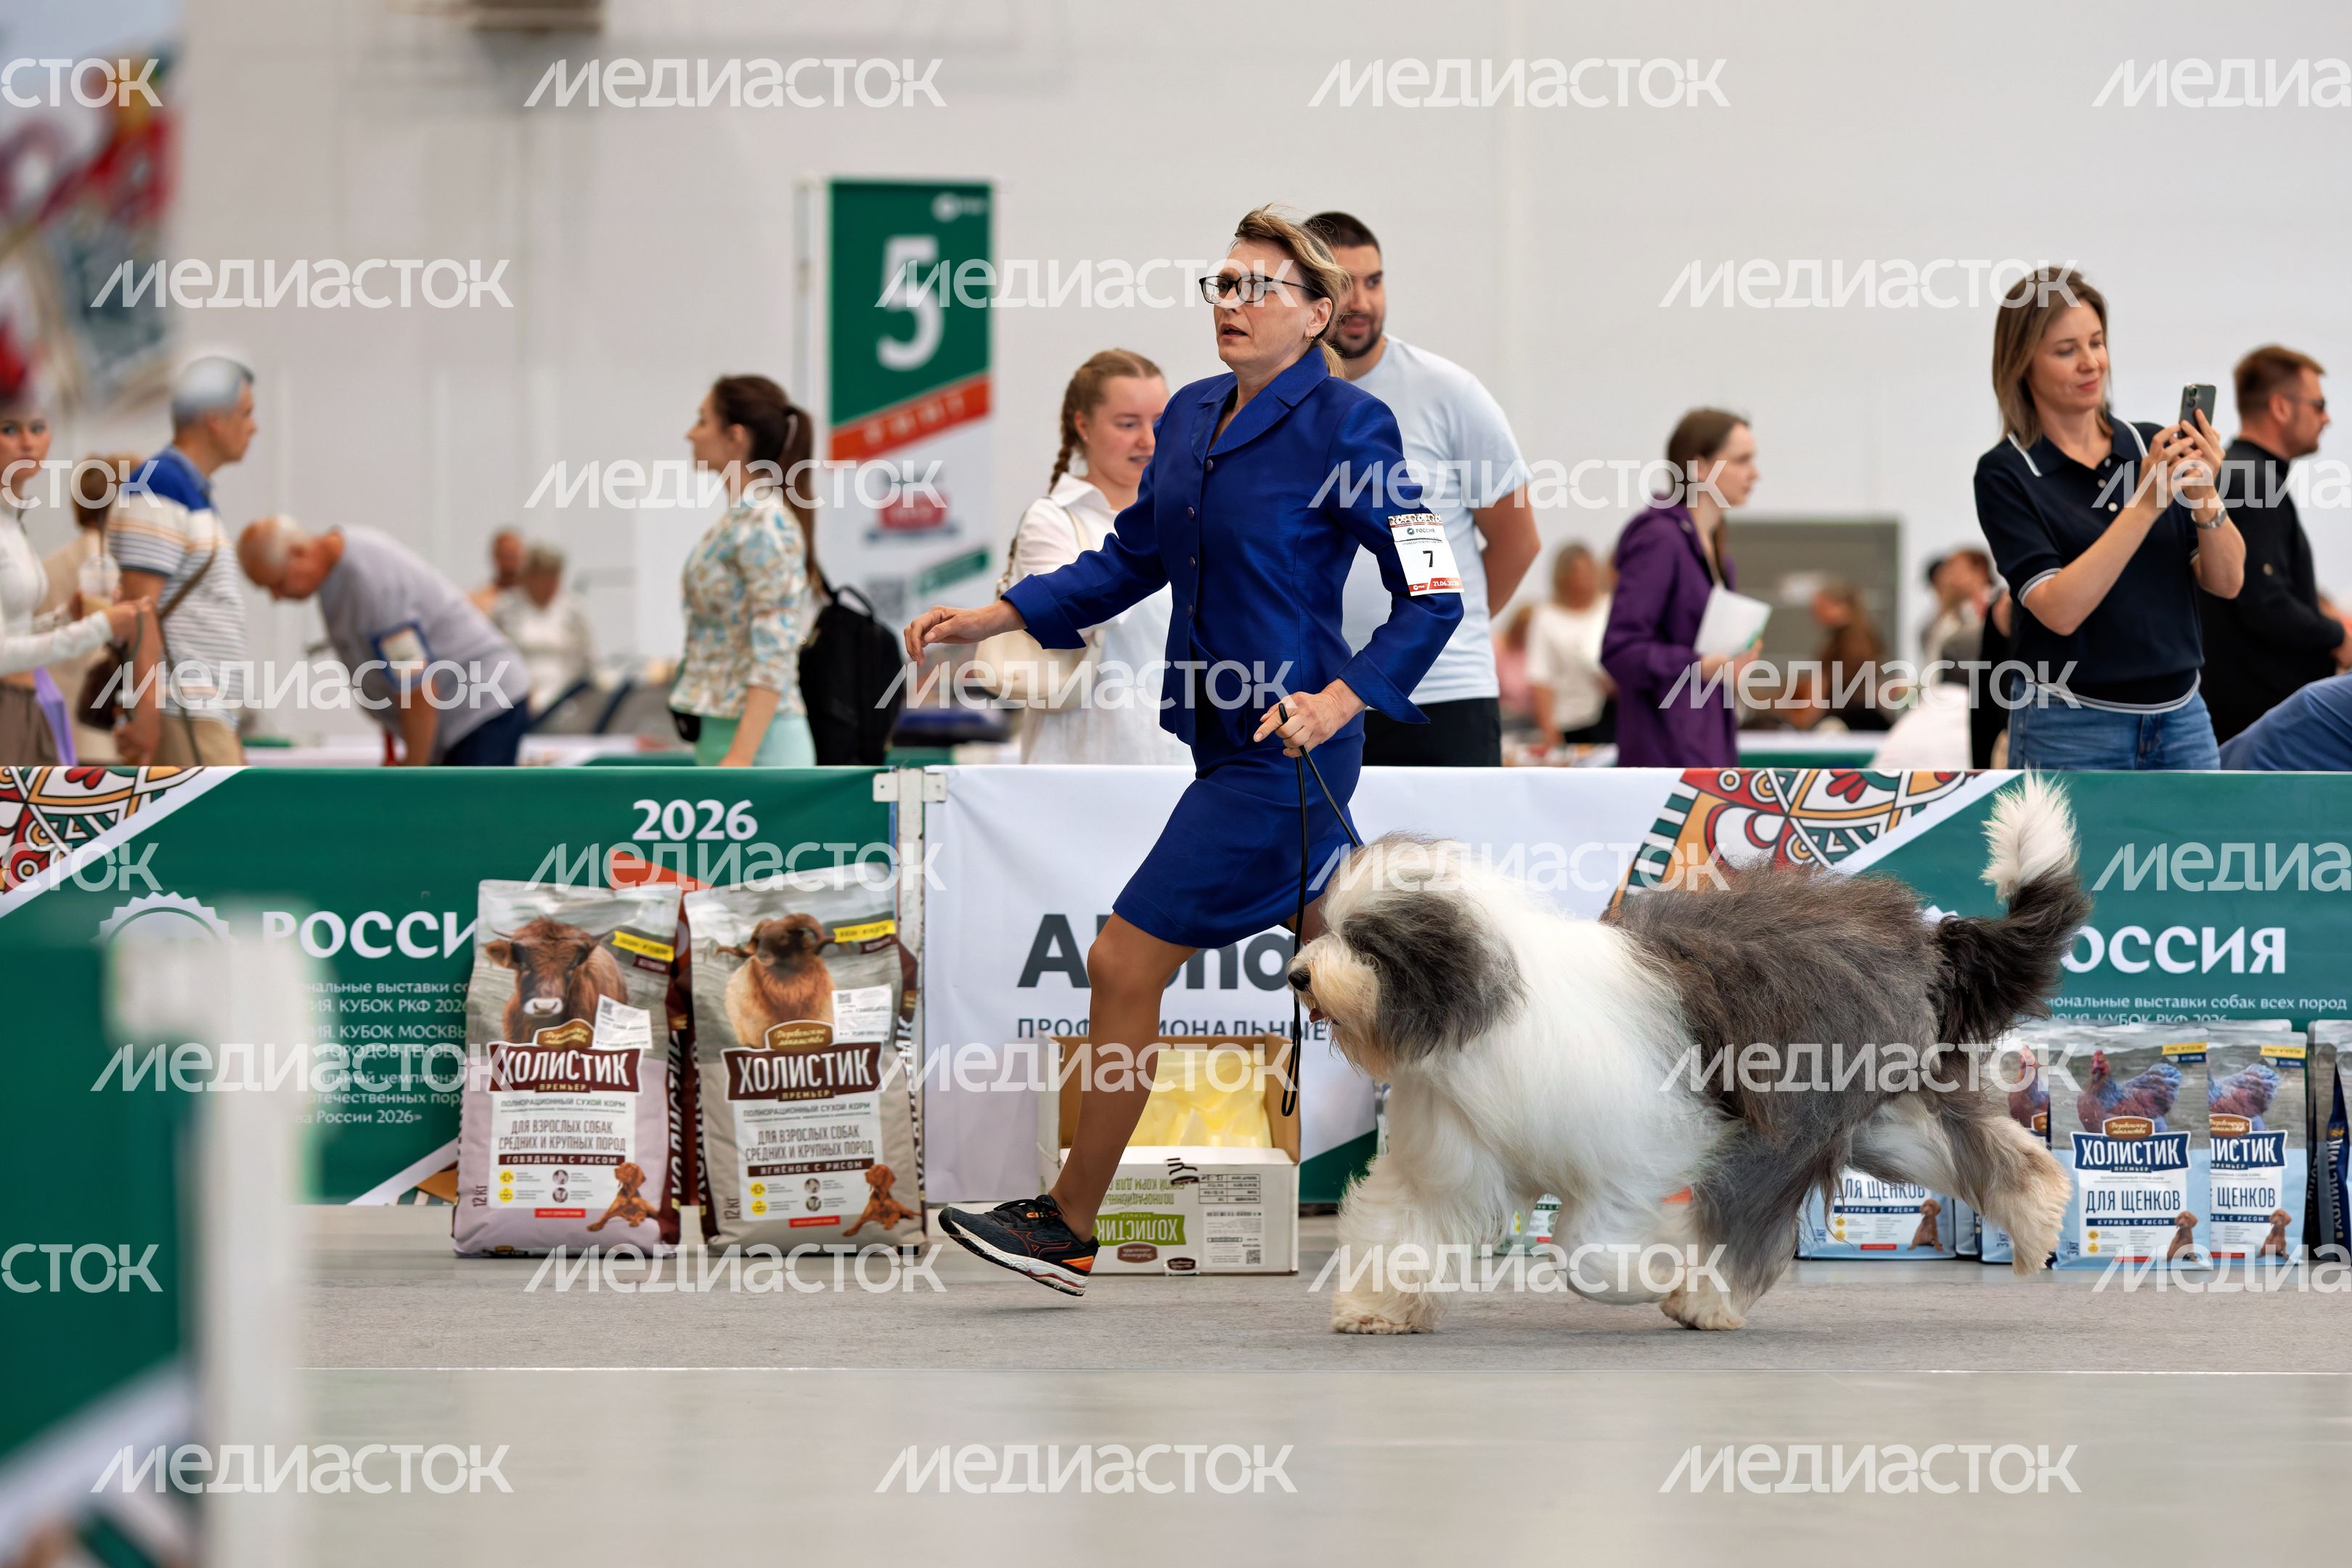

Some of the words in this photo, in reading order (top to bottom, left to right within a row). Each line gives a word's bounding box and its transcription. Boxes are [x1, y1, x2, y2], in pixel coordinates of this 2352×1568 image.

[875, 234, 945, 371] 5
[1423, 550, 1433, 568] 7
[632, 799, 759, 841] 2026
[377, 983, 449, 994] выставки
[340, 999, 393, 1013] КУБОК
[399, 998, 430, 1013] РКФ
[2135, 997, 2206, 1008] выставки
[2211, 995, 2255, 1008] собак
[2261, 997, 2295, 1008] всех
[2300, 997, 2347, 1011] пород
[340, 1024, 393, 1039] КУБОК
[499, 1050, 630, 1087] ХОЛИСТИК
[736, 1048, 873, 1095] ХОЛИСТИК
[539, 1083, 587, 1092] ПРЕМЬЕР
[782, 1089, 831, 1100] ПРЕМЬЕР
[576, 1098, 602, 1107] СУХОЙ
[820, 1103, 846, 1113] СУХОЙ
[317, 1109, 372, 1124] России
[511, 1119, 530, 1135] ДЛЯ
[533, 1119, 581, 1134] ВЗРОСЛЫХ
[584, 1120, 613, 1135] СОБАК
[758, 1130, 777, 1146] ДЛЯ
[780, 1127, 828, 1143] ВЗРОСЛЫХ
[831, 1124, 859, 1138] СОБАК
[499, 1137, 538, 1151] СРЕДНИХ
[540, 1137, 547, 1149] И
[549, 1136, 594, 1150] КРУПНЫХ
[596, 1137, 626, 1152] ПОРОД
[746, 1146, 786, 1161] СРЕДНИХ
[789, 1146, 796, 1159] И
[799, 1142, 842, 1157] КРУПНЫХ
[844, 1140, 875, 1155] ПОРОД
[2081, 1138, 2181, 1166] ХОЛИСТИК
[581, 1156, 618, 1164] РИСОМ
[825, 1161, 862, 1170] РИСОМ
[1135, 1178, 1159, 1191] КОРМ
[473, 1196, 488, 1207] 12
[2086, 1191, 2115, 1213] ДЛЯ
[2121, 1191, 2181, 1213] ЩЕНКОВ
[2217, 1186, 2276, 1209] ЩЕНКОВ
[724, 1209, 740, 1220] 12
[1095, 1218, 1178, 1242] ХОЛИСТИК
